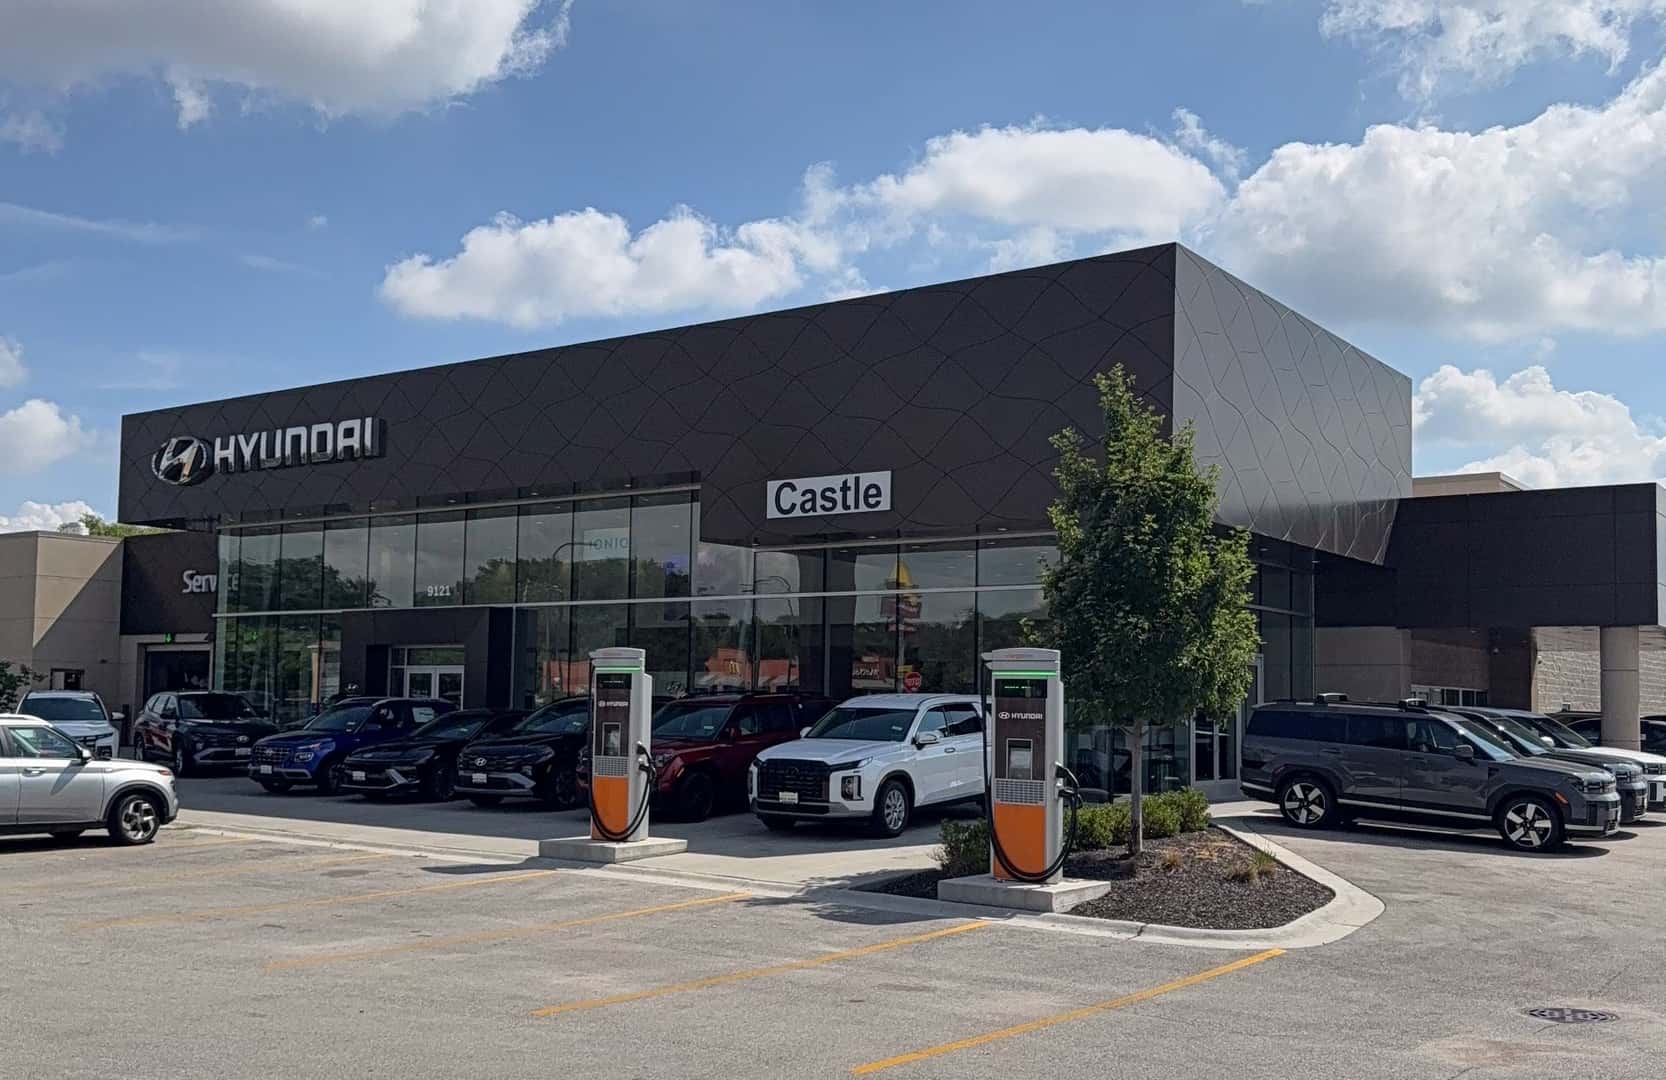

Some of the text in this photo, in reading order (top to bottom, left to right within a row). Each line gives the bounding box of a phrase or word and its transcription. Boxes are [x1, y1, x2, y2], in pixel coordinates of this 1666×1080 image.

[214, 416, 374, 473] HYUNDAI
[775, 476, 882, 515] Castle
[182, 570, 239, 593] Serve
[427, 585, 451, 597] 9121
